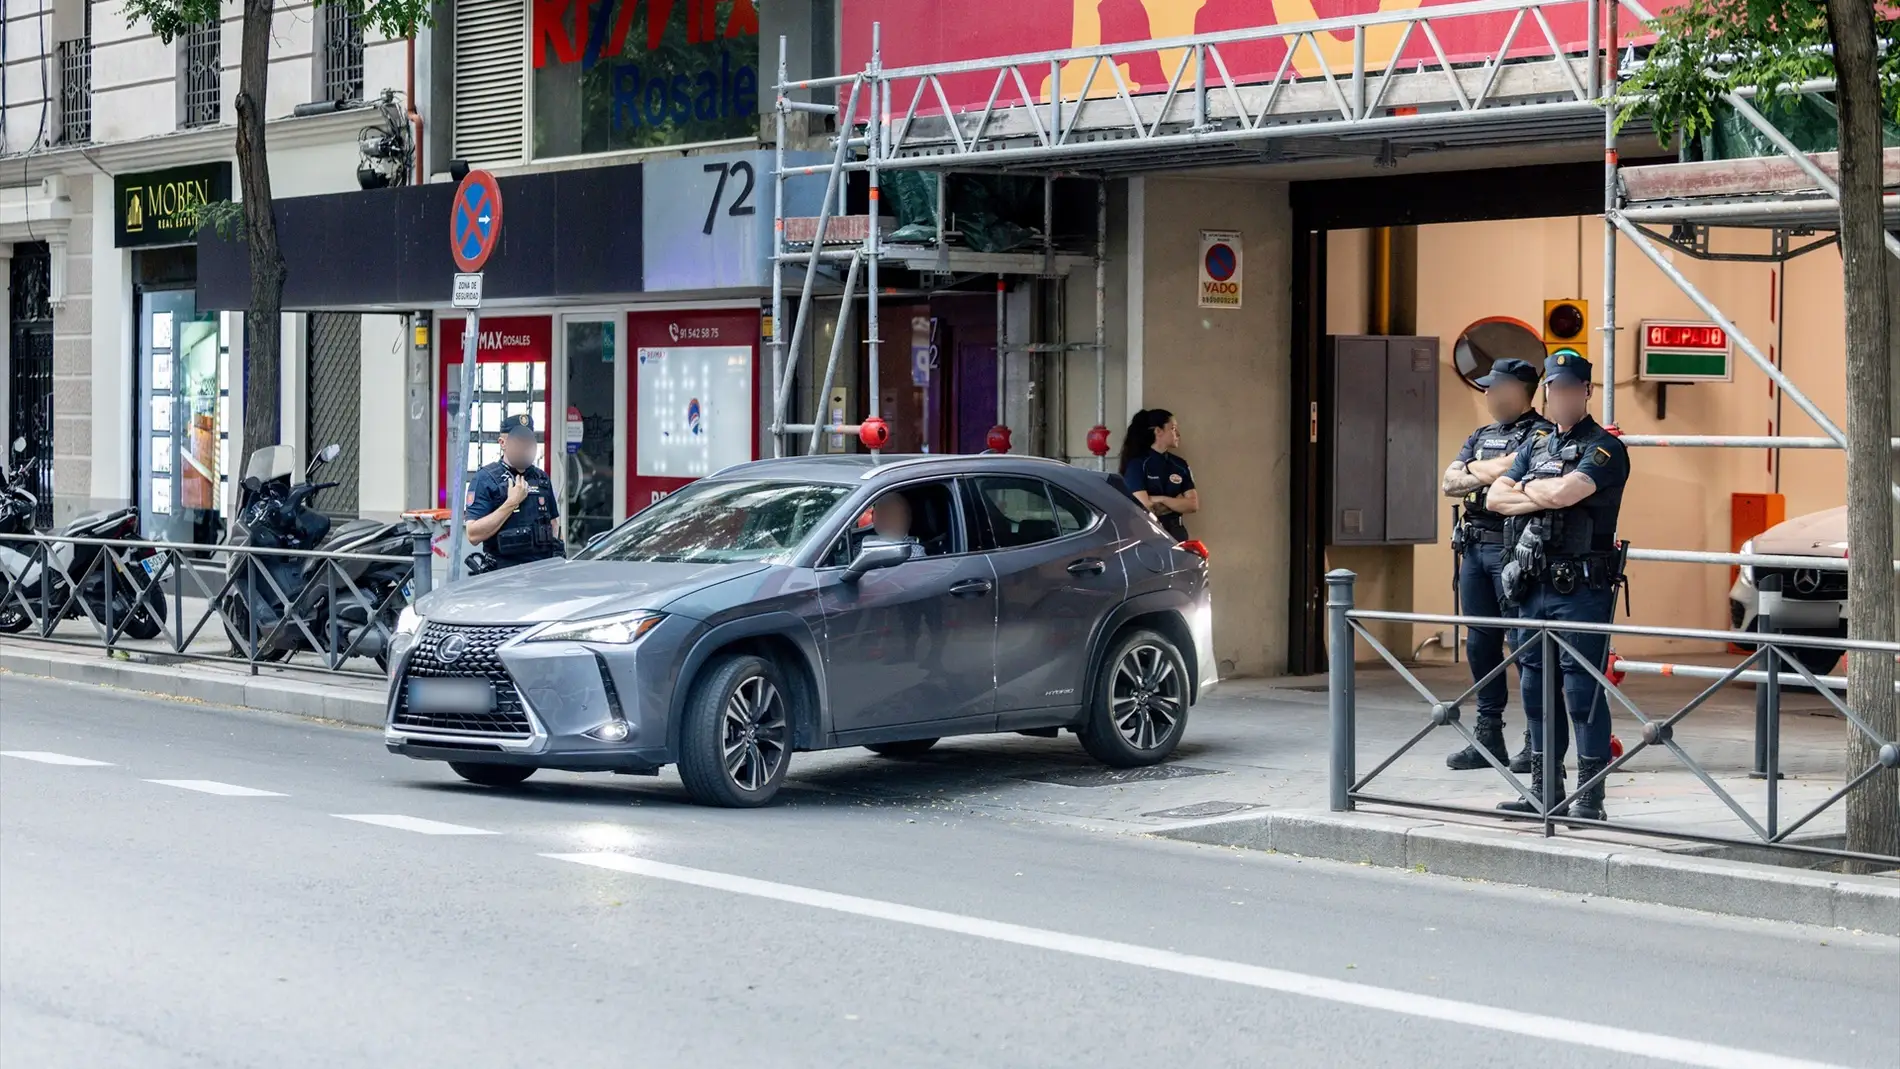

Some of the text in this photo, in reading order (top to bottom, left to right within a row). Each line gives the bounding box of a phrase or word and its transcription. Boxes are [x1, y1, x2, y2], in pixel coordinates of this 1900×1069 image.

[148, 179, 208, 217] MOBEN
[702, 160, 756, 236] 72
[158, 220, 173, 229] REAL
[1203, 282, 1238, 294] VADO
[455, 292, 479, 300] SEGURIDAD
[680, 328, 719, 339] 91 542 58 75
[502, 335, 531, 346] ROSALES
